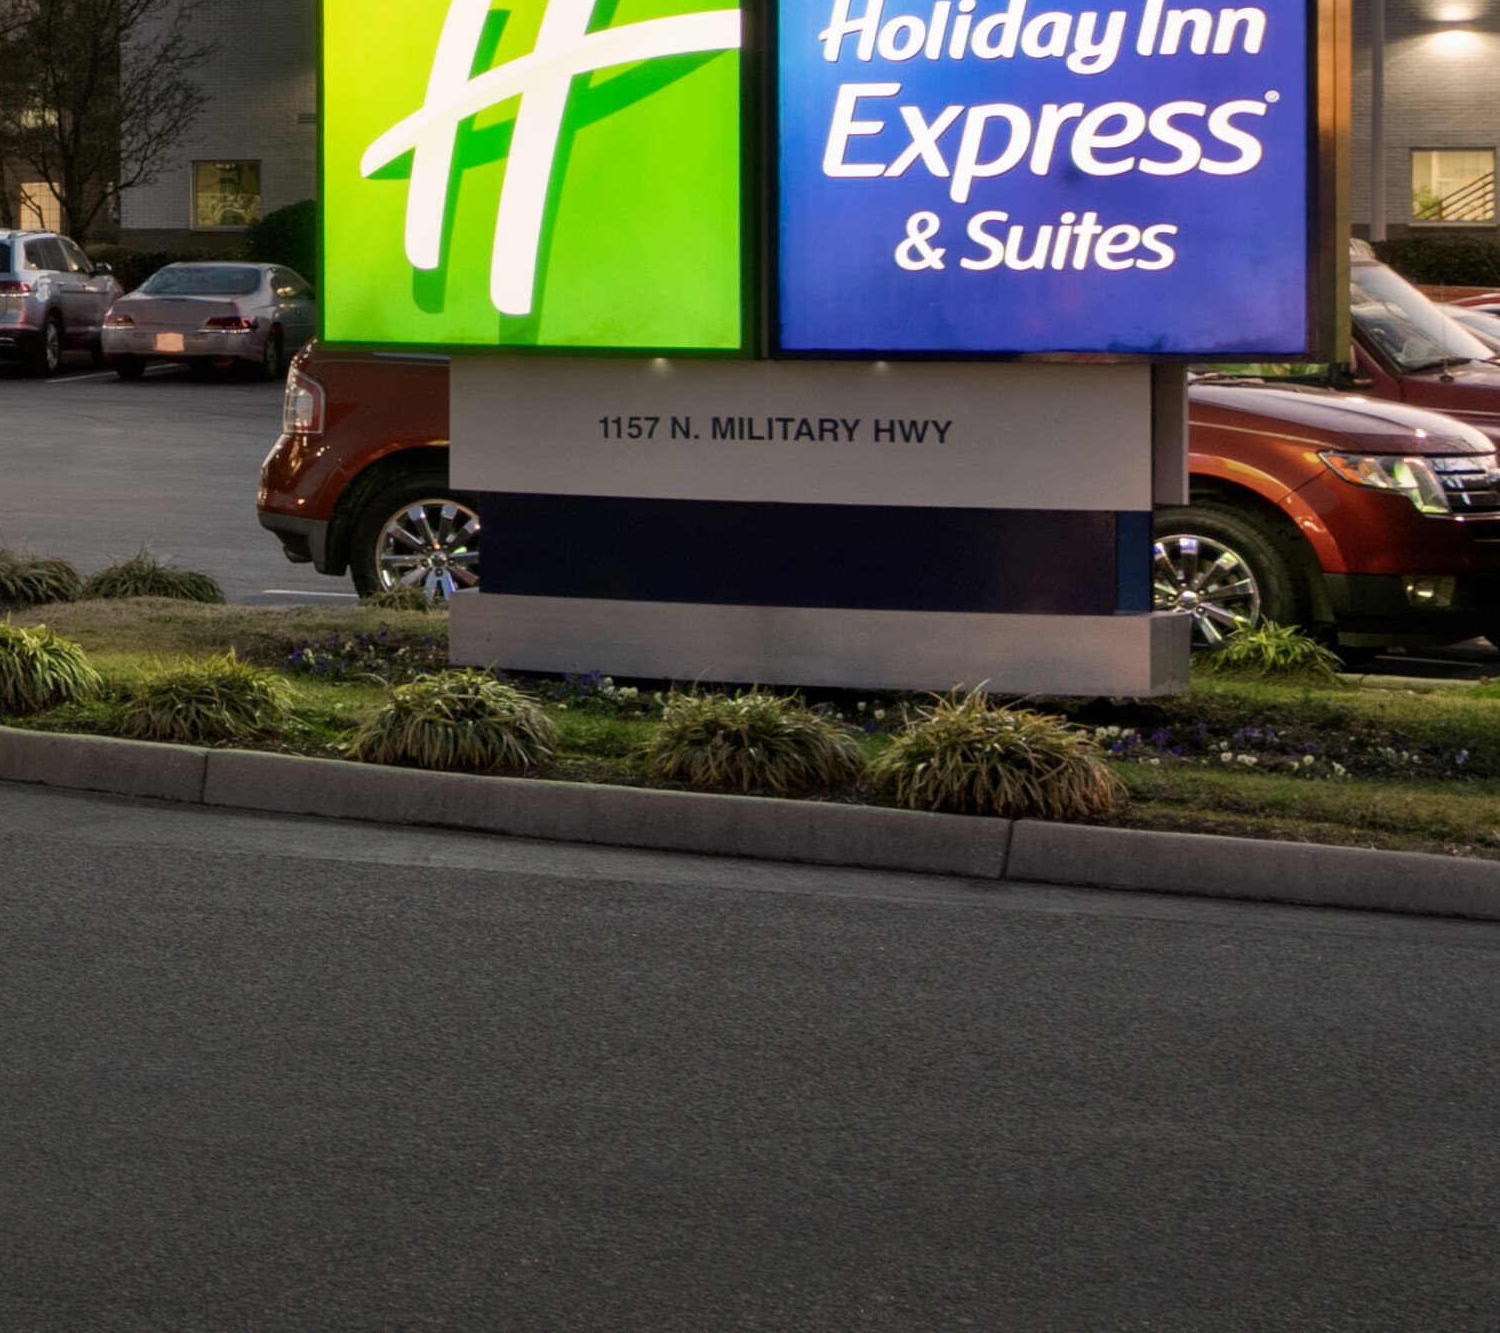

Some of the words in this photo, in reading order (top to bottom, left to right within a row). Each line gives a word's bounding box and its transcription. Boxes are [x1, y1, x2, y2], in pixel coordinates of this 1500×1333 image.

[895, 211, 946, 271] &
[960, 210, 1178, 271] Suites
[599, 416, 661, 440] 1157
[670, 416, 701, 441] N.
[711, 417, 861, 443] MILITARY
[873, 419, 954, 445] HWY
